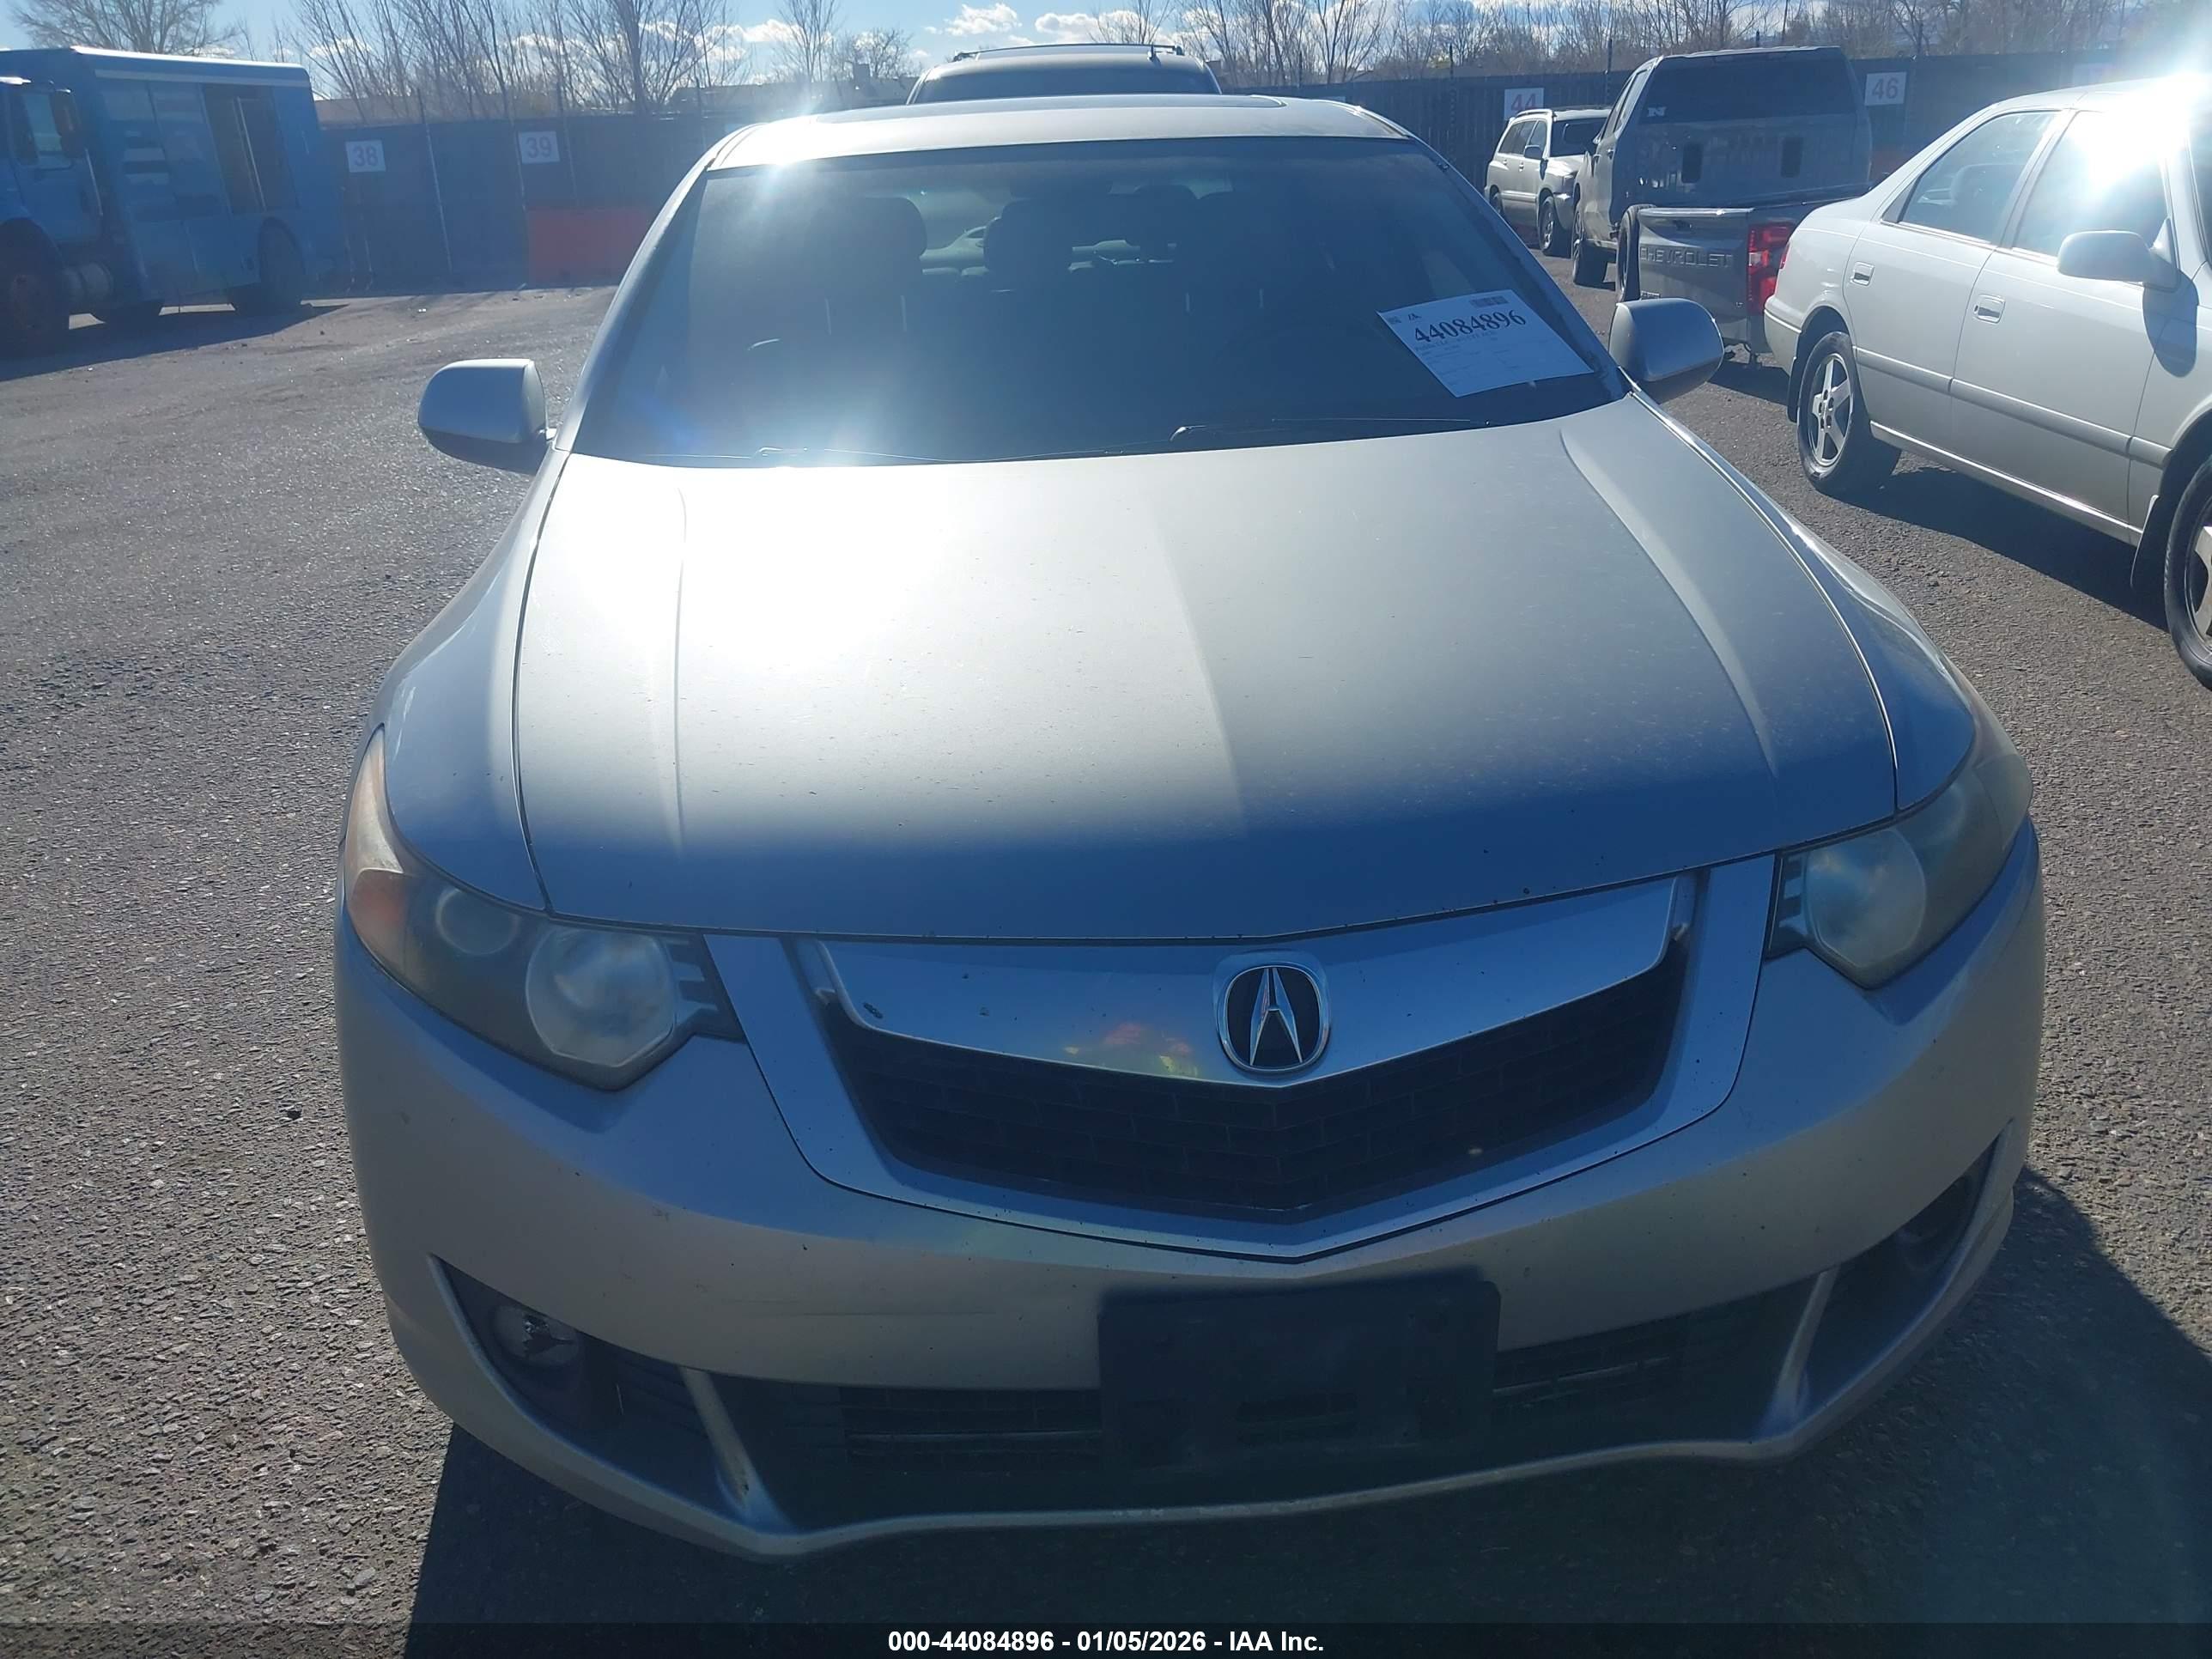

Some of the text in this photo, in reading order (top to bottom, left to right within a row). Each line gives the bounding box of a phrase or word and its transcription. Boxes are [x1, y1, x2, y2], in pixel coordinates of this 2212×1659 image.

[1872, 77, 1899, 100] 46
[1511, 94, 1536, 110] 44
[353, 145, 378, 167] 38
[526, 137, 552, 158] 39
[1641, 246, 1733, 268] CHEVROLET
[1415, 309, 1526, 343] 44084896
